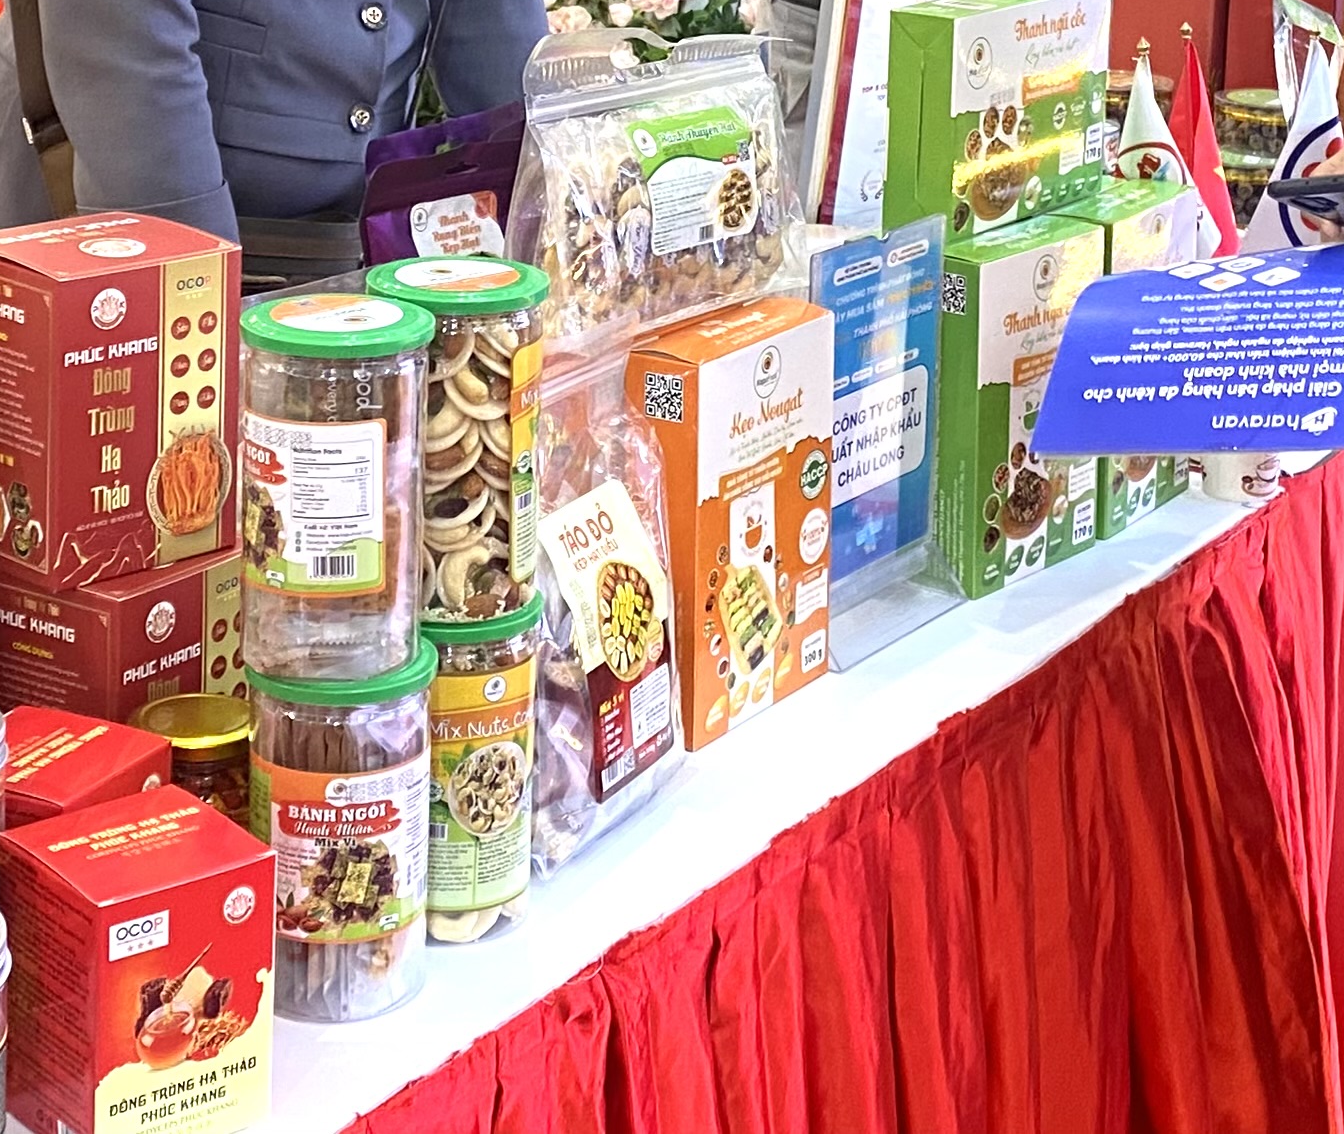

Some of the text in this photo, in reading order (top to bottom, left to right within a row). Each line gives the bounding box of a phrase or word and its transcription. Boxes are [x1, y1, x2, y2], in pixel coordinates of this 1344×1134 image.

[1014, 1, 1086, 42] Thanh ngũ cốc
[1086, 146, 1096, 159] 170
[176, 275, 211, 291] OCOP
[1003, 305, 1041, 336] Thanh
[64, 336, 158, 368] PHÚC KHANG
[1162, 352, 1205, 362] 60.000+
[92, 367, 132, 396] Đông
[1183, 366, 1234, 382] doanh
[1238, 365, 1275, 381] kinh
[1278, 363, 1310, 380] nhà
[1083, 378, 1342, 404] Giải pháp bán hàng đa kênh cho
[87, 404, 135, 437] Trùng
[729, 387, 804, 440] Kẹo Nougat
[832, 387, 918, 437] CÔNG TY CPĐT
[1211, 413, 1299, 431] haravan
[831, 433, 854, 464] UẤT
[856, 425, 889, 452] NHẬP
[890, 404, 922, 439] KHẨU
[101, 445, 122, 474] Hạ
[837, 444, 905, 487] CHÂU LONG
[800, 459, 829, 488] HACCP
[91, 479, 130, 514] Thảo
[559, 502, 614, 558] TÁO ĐỎ
[1074, 525, 1087, 540] 170
[30, 618, 75, 643] KHANG
[123, 642, 201, 686] PHÚC KHANG
[804, 650, 817, 667] 300
[430, 716, 509, 740] Mix Nuts
[288, 803, 338, 823] BÁNH
[314, 838, 340, 848] Mix
[116, 916, 164, 941] OCOP
[109, 1093, 147, 1117] ĐÔNG
[181, 1085, 227, 1113] KHANG
